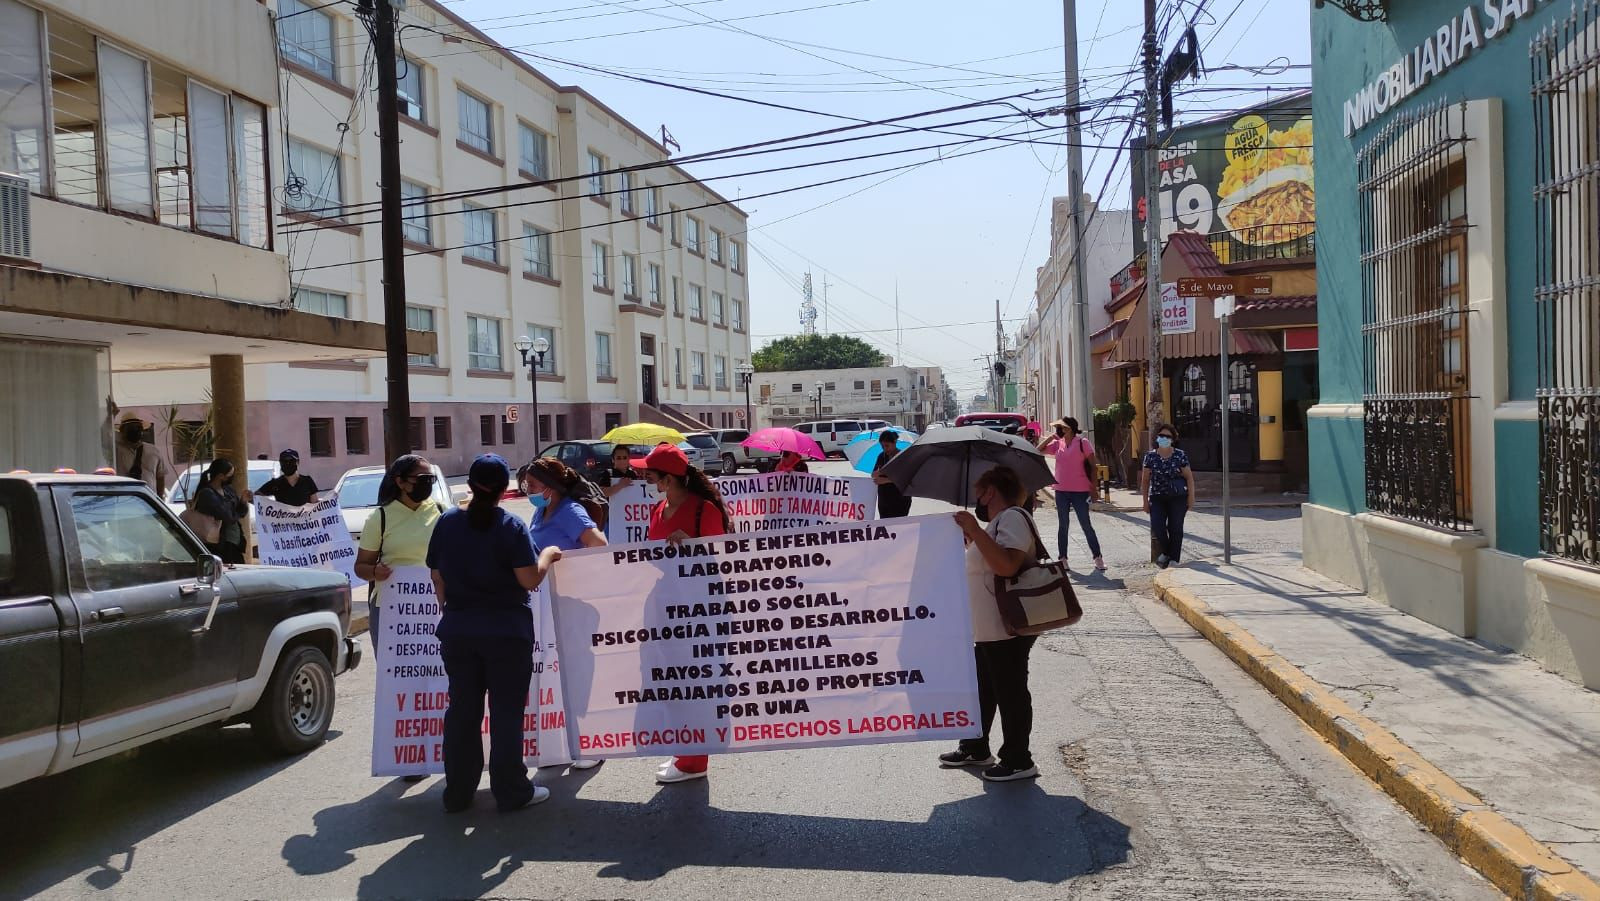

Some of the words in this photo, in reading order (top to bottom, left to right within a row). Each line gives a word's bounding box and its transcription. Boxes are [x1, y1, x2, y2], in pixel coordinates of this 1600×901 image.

[1343, 5, 1479, 138] INMOBILIARIA
[1234, 129, 1259, 147] AGUA
[1180, 283, 1186, 292] 5
[1190, 283, 1203, 292] de
[1207, 282, 1233, 293] Mayo
[767, 474, 829, 496] EVENTUAL
[833, 479, 850, 497] DE
[727, 499, 766, 517] SALUD
[769, 497, 783, 514] DE
[787, 496, 866, 521] TAMAULIPAS
[613, 541, 720, 565] PERSONAL
[724, 538, 750, 554] DE
[755, 524, 897, 551] ENFERMERÍA,
[309, 553, 319, 566] la
[320, 547, 355, 566] promesa
[678, 552, 831, 578] LABORATORIO,
[396, 582, 437, 595] TRABA
[708, 575, 804, 596] MÉDICOS,
[397, 603, 441, 616] VELADO
[665, 599, 761, 620] TRABAJO
[766, 592, 849, 612] SOCIAL,
[591, 621, 711, 647] PSICOLOGÍA
[716, 617, 784, 636] NEURO
[790, 605, 936, 630] DESARROLLO.
[692, 634, 832, 659] INTENDENCIA
[393, 665, 446, 678] PERSONAL
[651, 664, 713, 682] RAYOS
[719, 662, 742, 678] X,
[746, 651, 879, 675] CAMILLEROS
[614, 681, 750, 705] TRABAJAMOS
[756, 677, 810, 696] BAJO
[816, 669, 925, 691] PROTESTA
[396, 693, 406, 712] Y
[539, 688, 554, 706] LA
[716, 702, 760, 719] POR
[764, 698, 810, 715] UNA
[541, 711, 566, 730] UNA
[579, 724, 706, 749] BASIFICACIÓN
[715, 727, 728, 743] Y
[733, 719, 842, 742] DERECHOS
[847, 710, 975, 734] LABORALES.
[394, 744, 427, 764] VIDA
